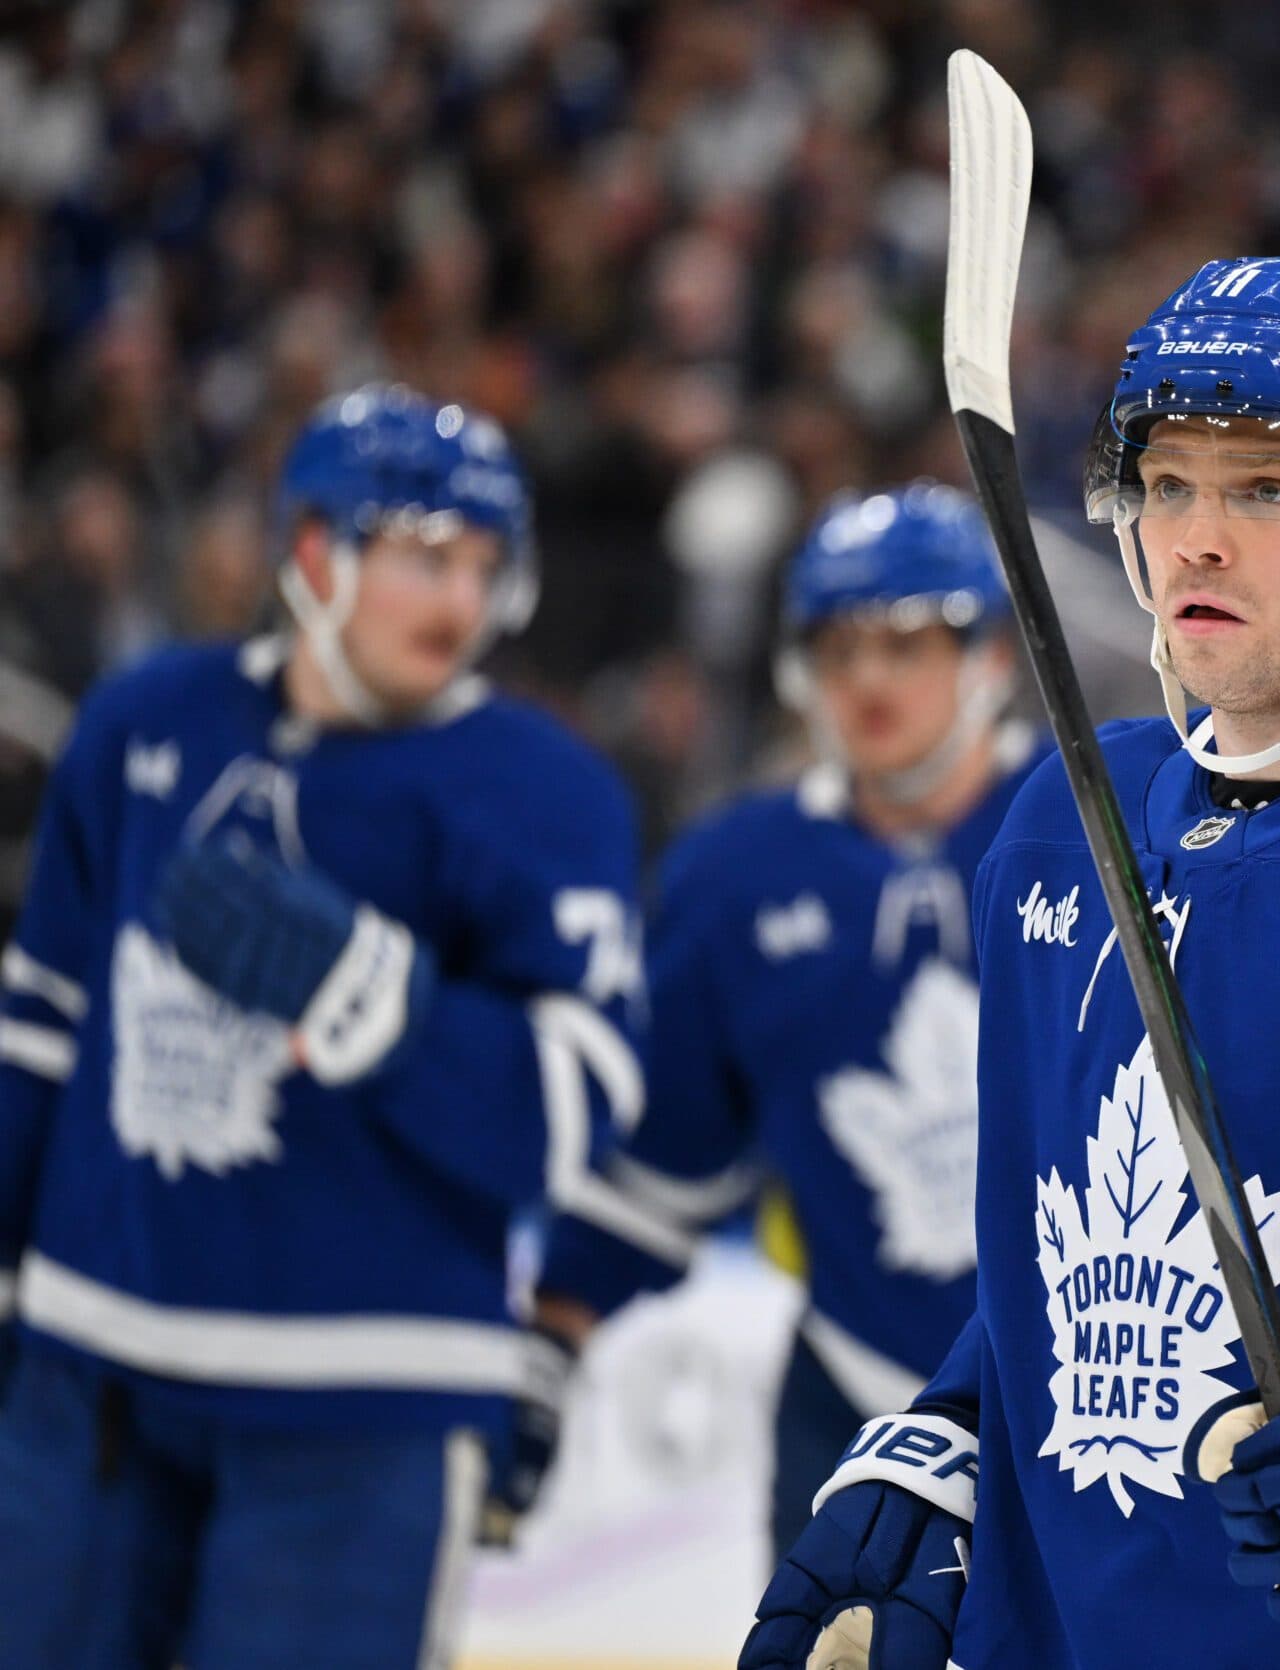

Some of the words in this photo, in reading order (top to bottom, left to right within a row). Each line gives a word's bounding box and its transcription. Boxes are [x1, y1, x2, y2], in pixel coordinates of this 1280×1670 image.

[1211, 268, 1262, 297] 11
[1017, 881, 1080, 947] Milk
[1056, 1253, 1223, 1333] TORONTO
[1074, 1321, 1182, 1368] MAPLE
[1072, 1373, 1180, 1420] LEAFS
